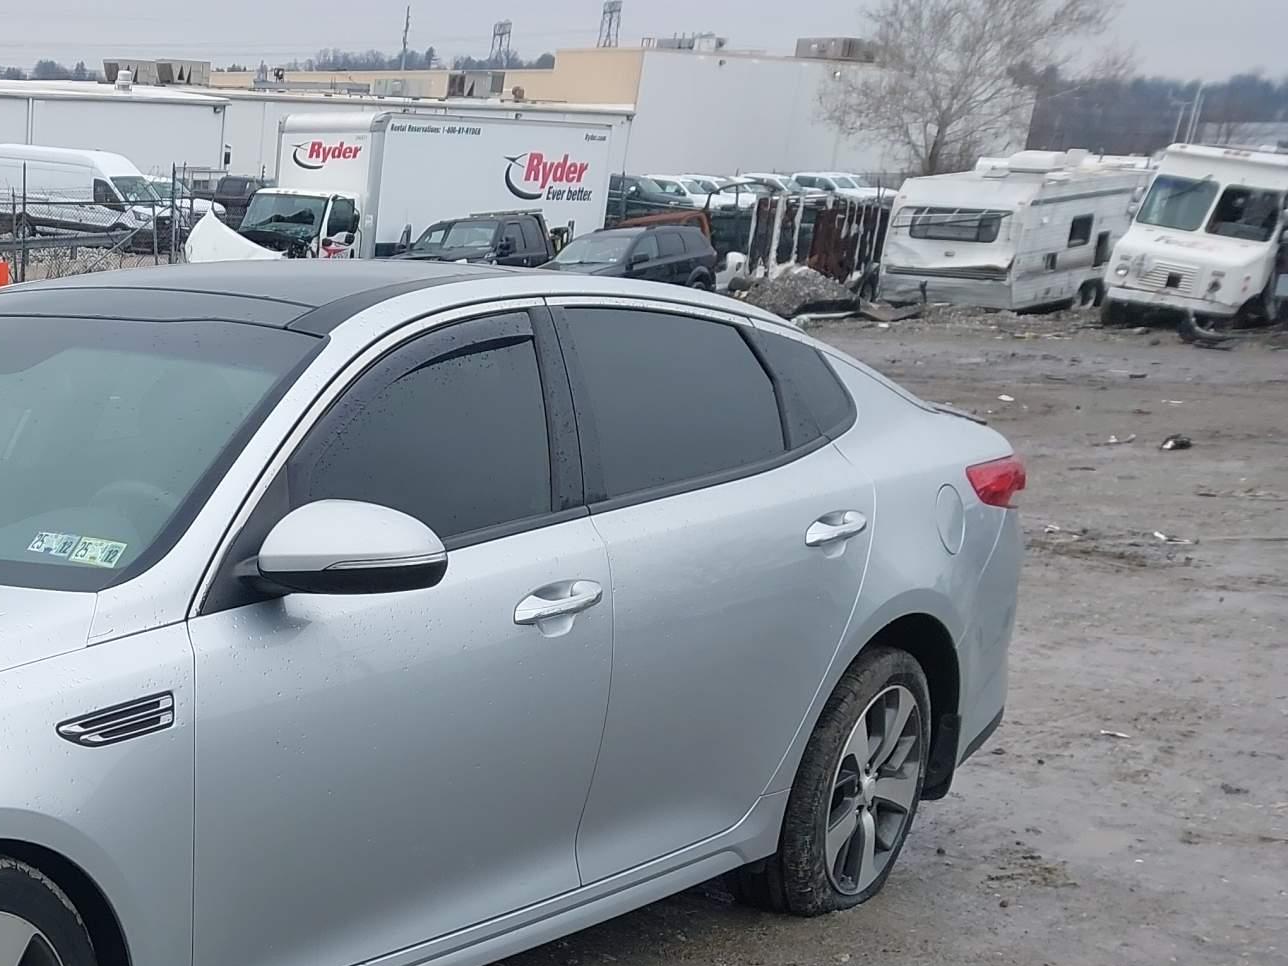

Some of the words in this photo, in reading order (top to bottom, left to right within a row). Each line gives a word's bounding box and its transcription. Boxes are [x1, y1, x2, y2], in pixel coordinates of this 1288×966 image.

[308, 141, 362, 162] Ryder
[524, 152, 588, 188] Ryder
[546, 186, 566, 200] Ever
[566, 186, 592, 201] better.
[32, 533, 49, 549] 25
[58, 540, 73, 553] 12
[74, 541, 92, 558] 25
[104, 549, 119, 563] 12
